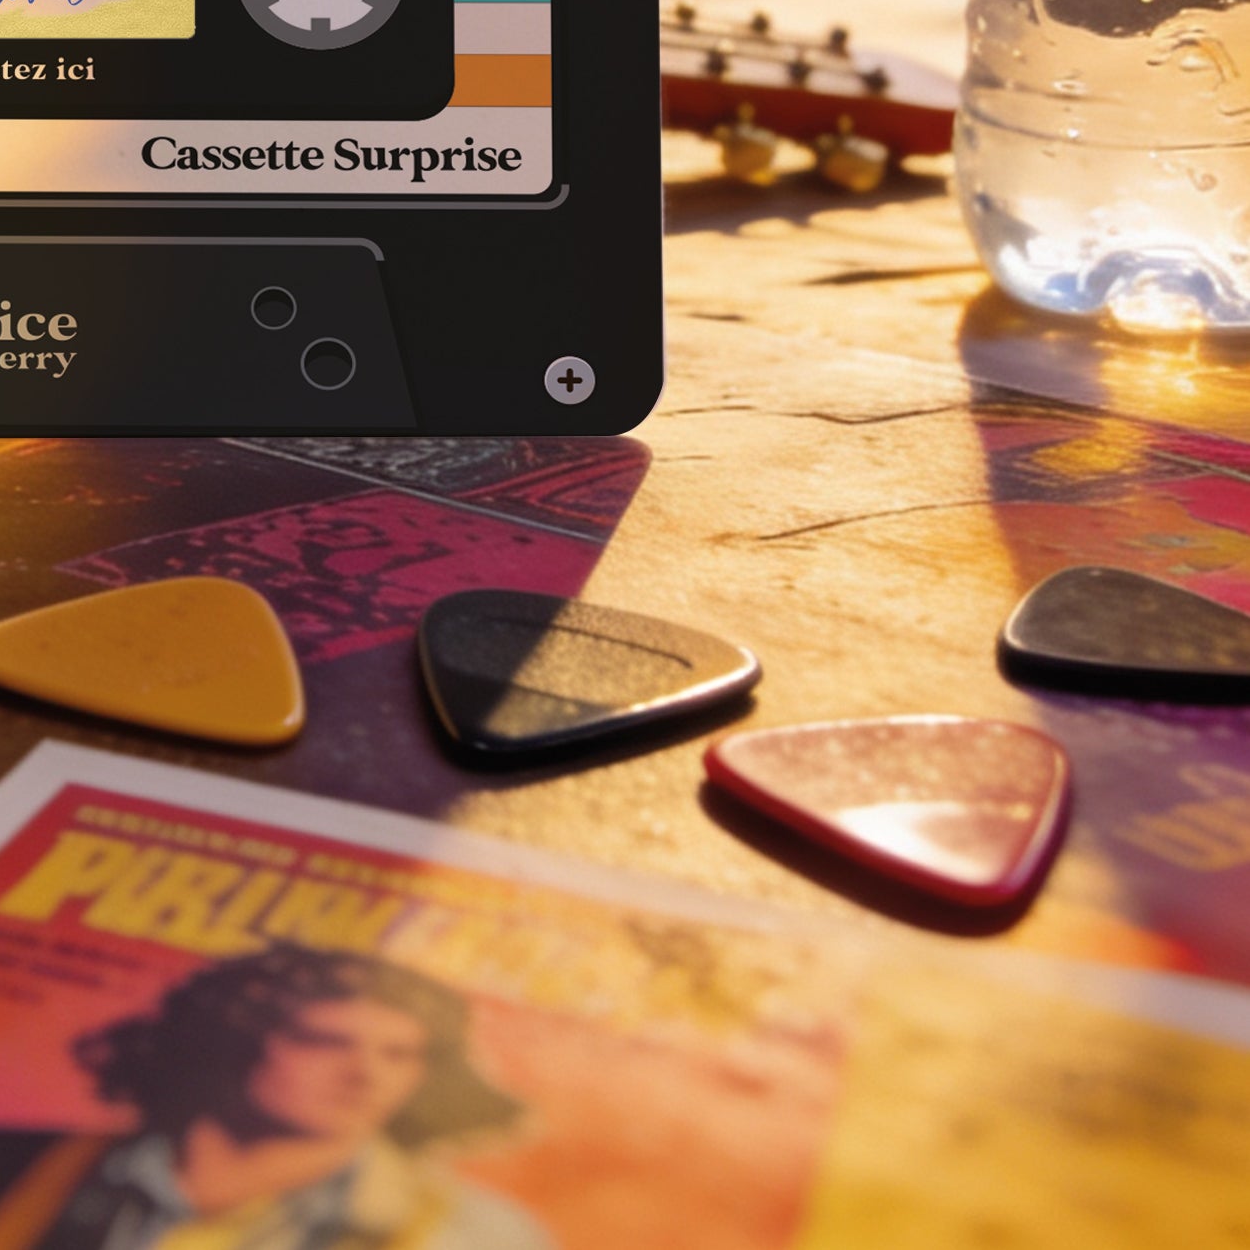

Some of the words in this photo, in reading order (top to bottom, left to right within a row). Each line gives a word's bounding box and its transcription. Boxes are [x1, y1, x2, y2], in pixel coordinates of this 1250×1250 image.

[56, 57, 96, 80] ici
[141, 136, 325, 171] Cassette
[334, 136, 522, 183] Surprise
